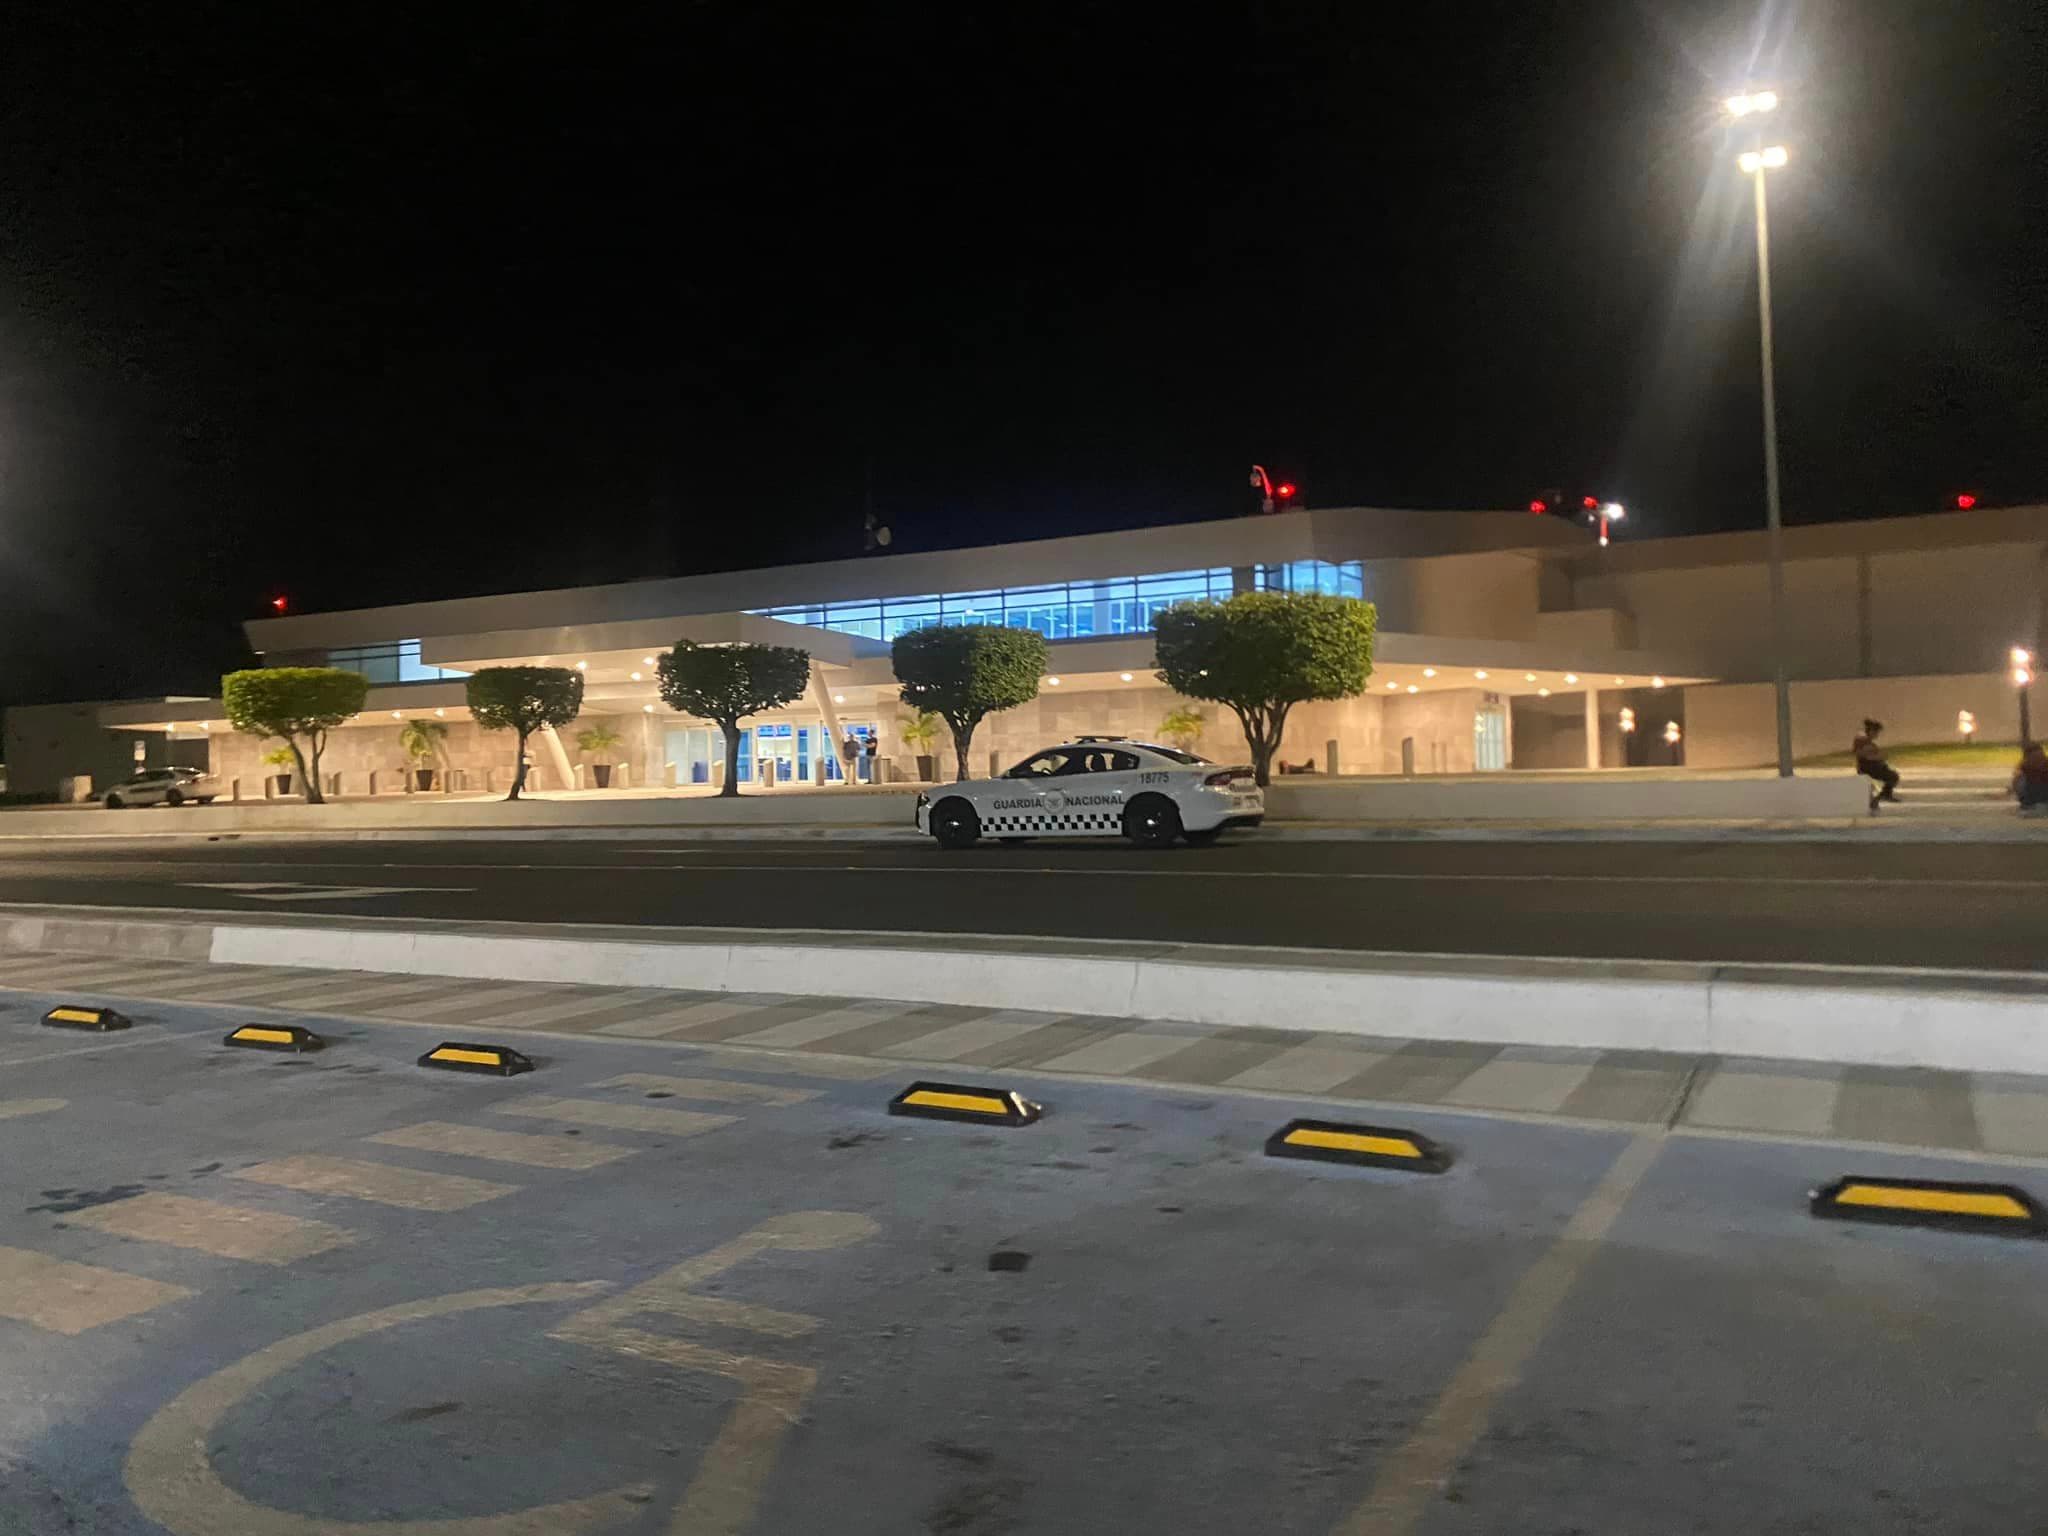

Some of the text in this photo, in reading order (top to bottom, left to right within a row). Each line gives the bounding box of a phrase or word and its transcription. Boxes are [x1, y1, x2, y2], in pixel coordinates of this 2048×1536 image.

[1139, 772, 1170, 784] 18775
[993, 795, 1125, 810] GUARDIA NACIONAL
